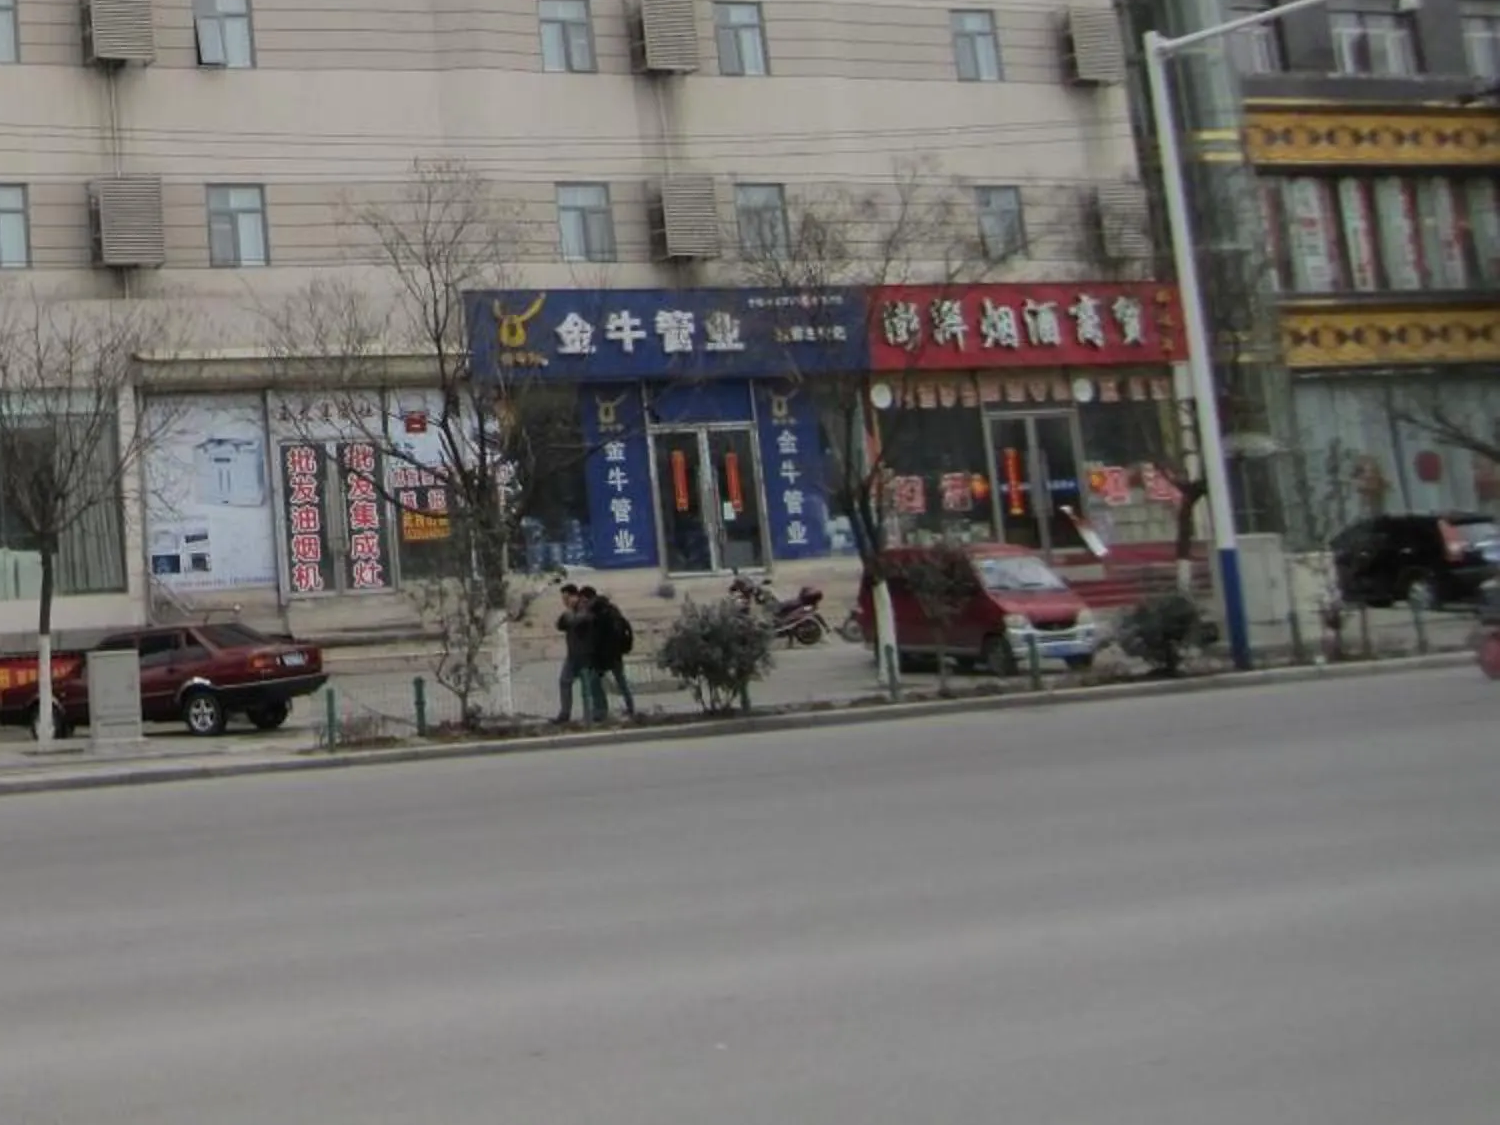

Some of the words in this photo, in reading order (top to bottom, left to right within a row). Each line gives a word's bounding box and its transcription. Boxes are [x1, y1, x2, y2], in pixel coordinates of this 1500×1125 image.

[553, 309, 746, 355] 金牛管业
[285, 446, 324, 592] 批发油烟机
[343, 443, 383, 588] 批发集成灶
[604, 441, 637, 554] 金牛管业
[775, 429, 808, 544] 金牛管业
